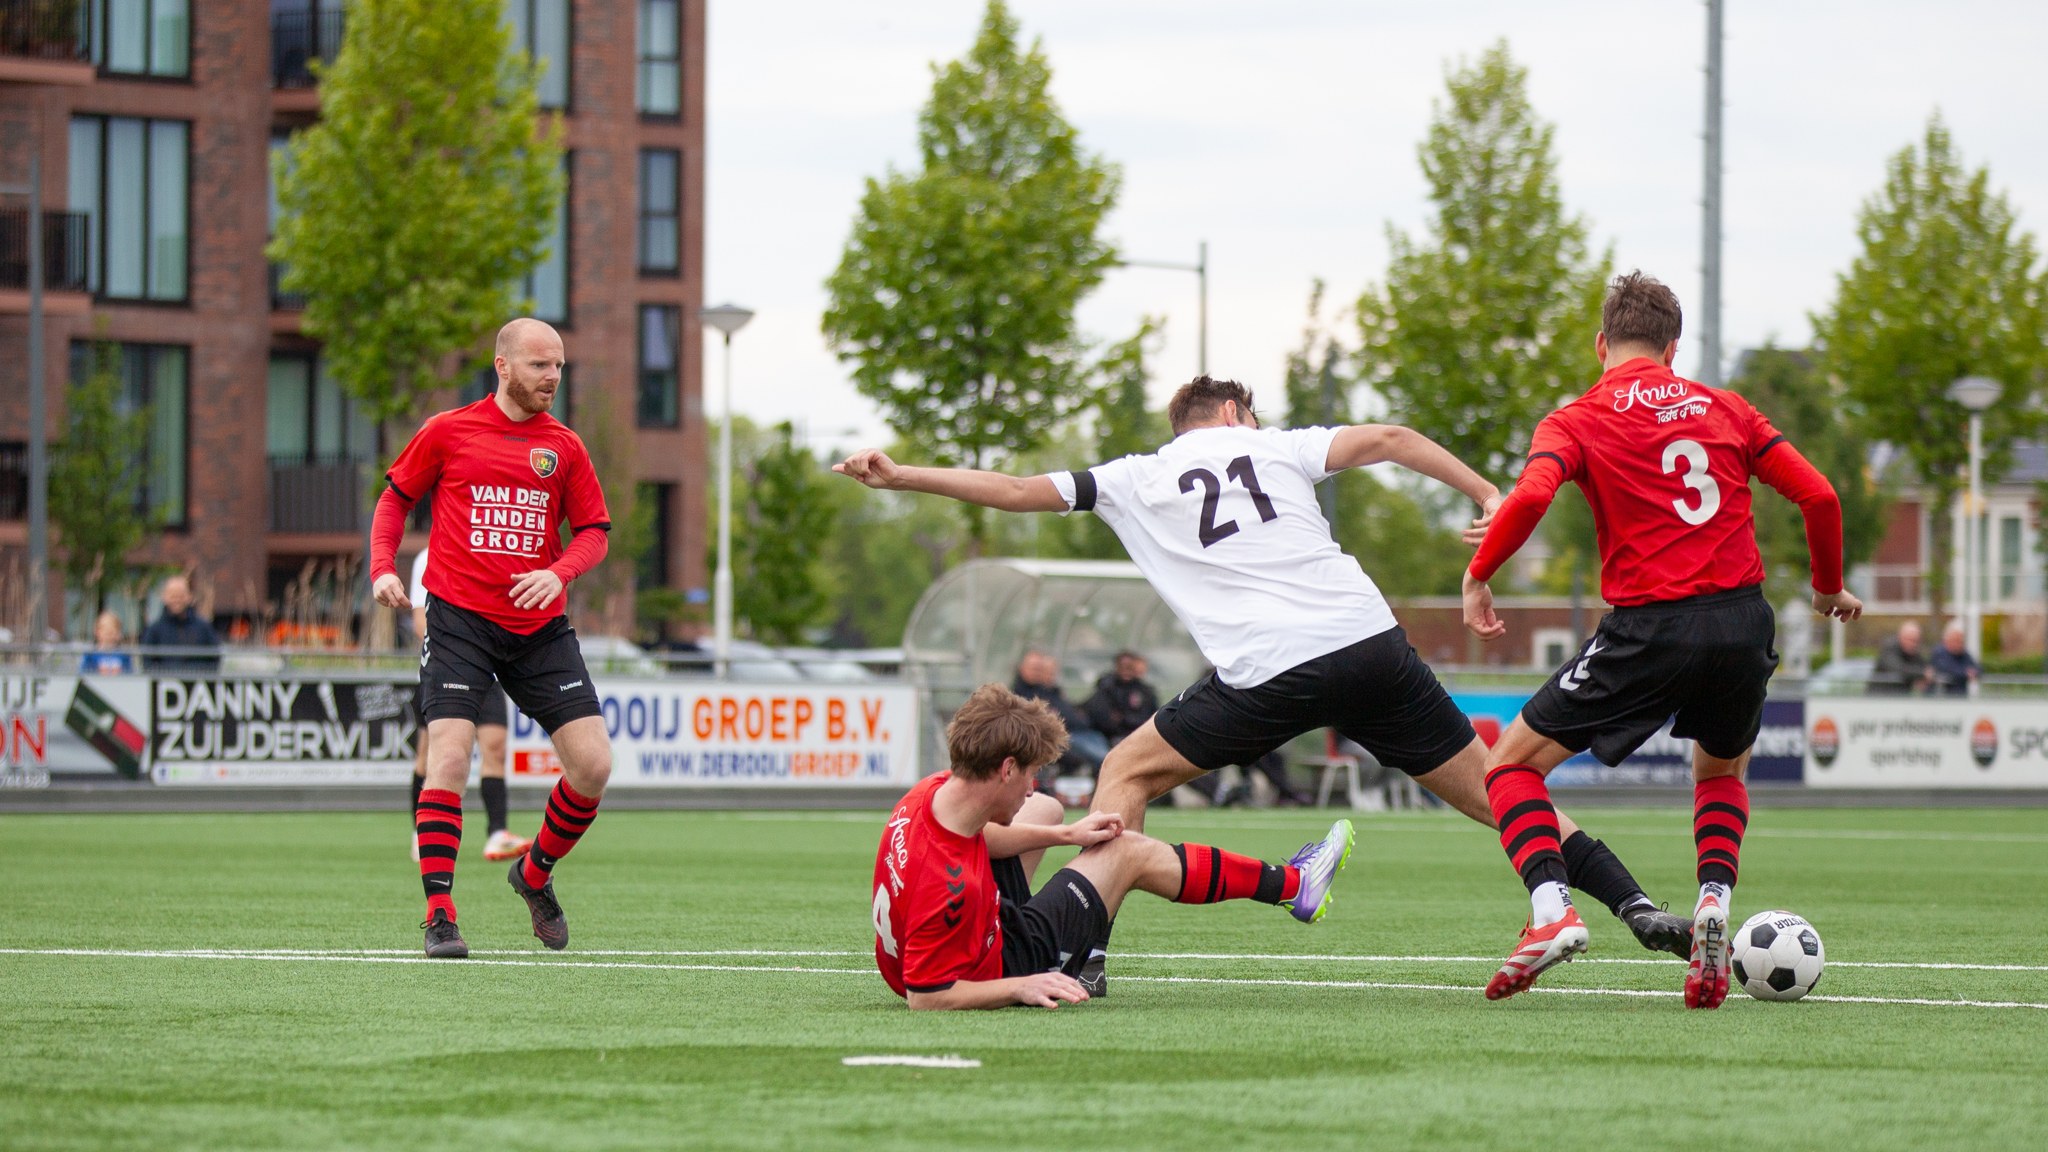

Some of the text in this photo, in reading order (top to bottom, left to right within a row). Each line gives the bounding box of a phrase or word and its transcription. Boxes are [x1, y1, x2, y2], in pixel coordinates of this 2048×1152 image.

[1613, 379, 1702, 413] Amici
[1655, 409, 1679, 424] Taste
[1679, 404, 1690, 420] of
[470, 485, 550, 508] VAN DER
[1661, 439, 1721, 526] 3
[1178, 454, 1278, 549] 21
[470, 508, 546, 531] LINDEN
[470, 530, 544, 552] GROEP
[156, 680, 302, 721] DANNY
[559, 679, 583, 691] hummel
[602, 696, 680, 740] OOIJ
[693, 696, 813, 741] GROEP
[827, 696, 890, 741] B.V.
[156, 721, 418, 761] ZUIJDERWIJK
[638, 752, 888, 777] WWW.DEROOIJGROEP.NL
[873, 883, 898, 959] 4
